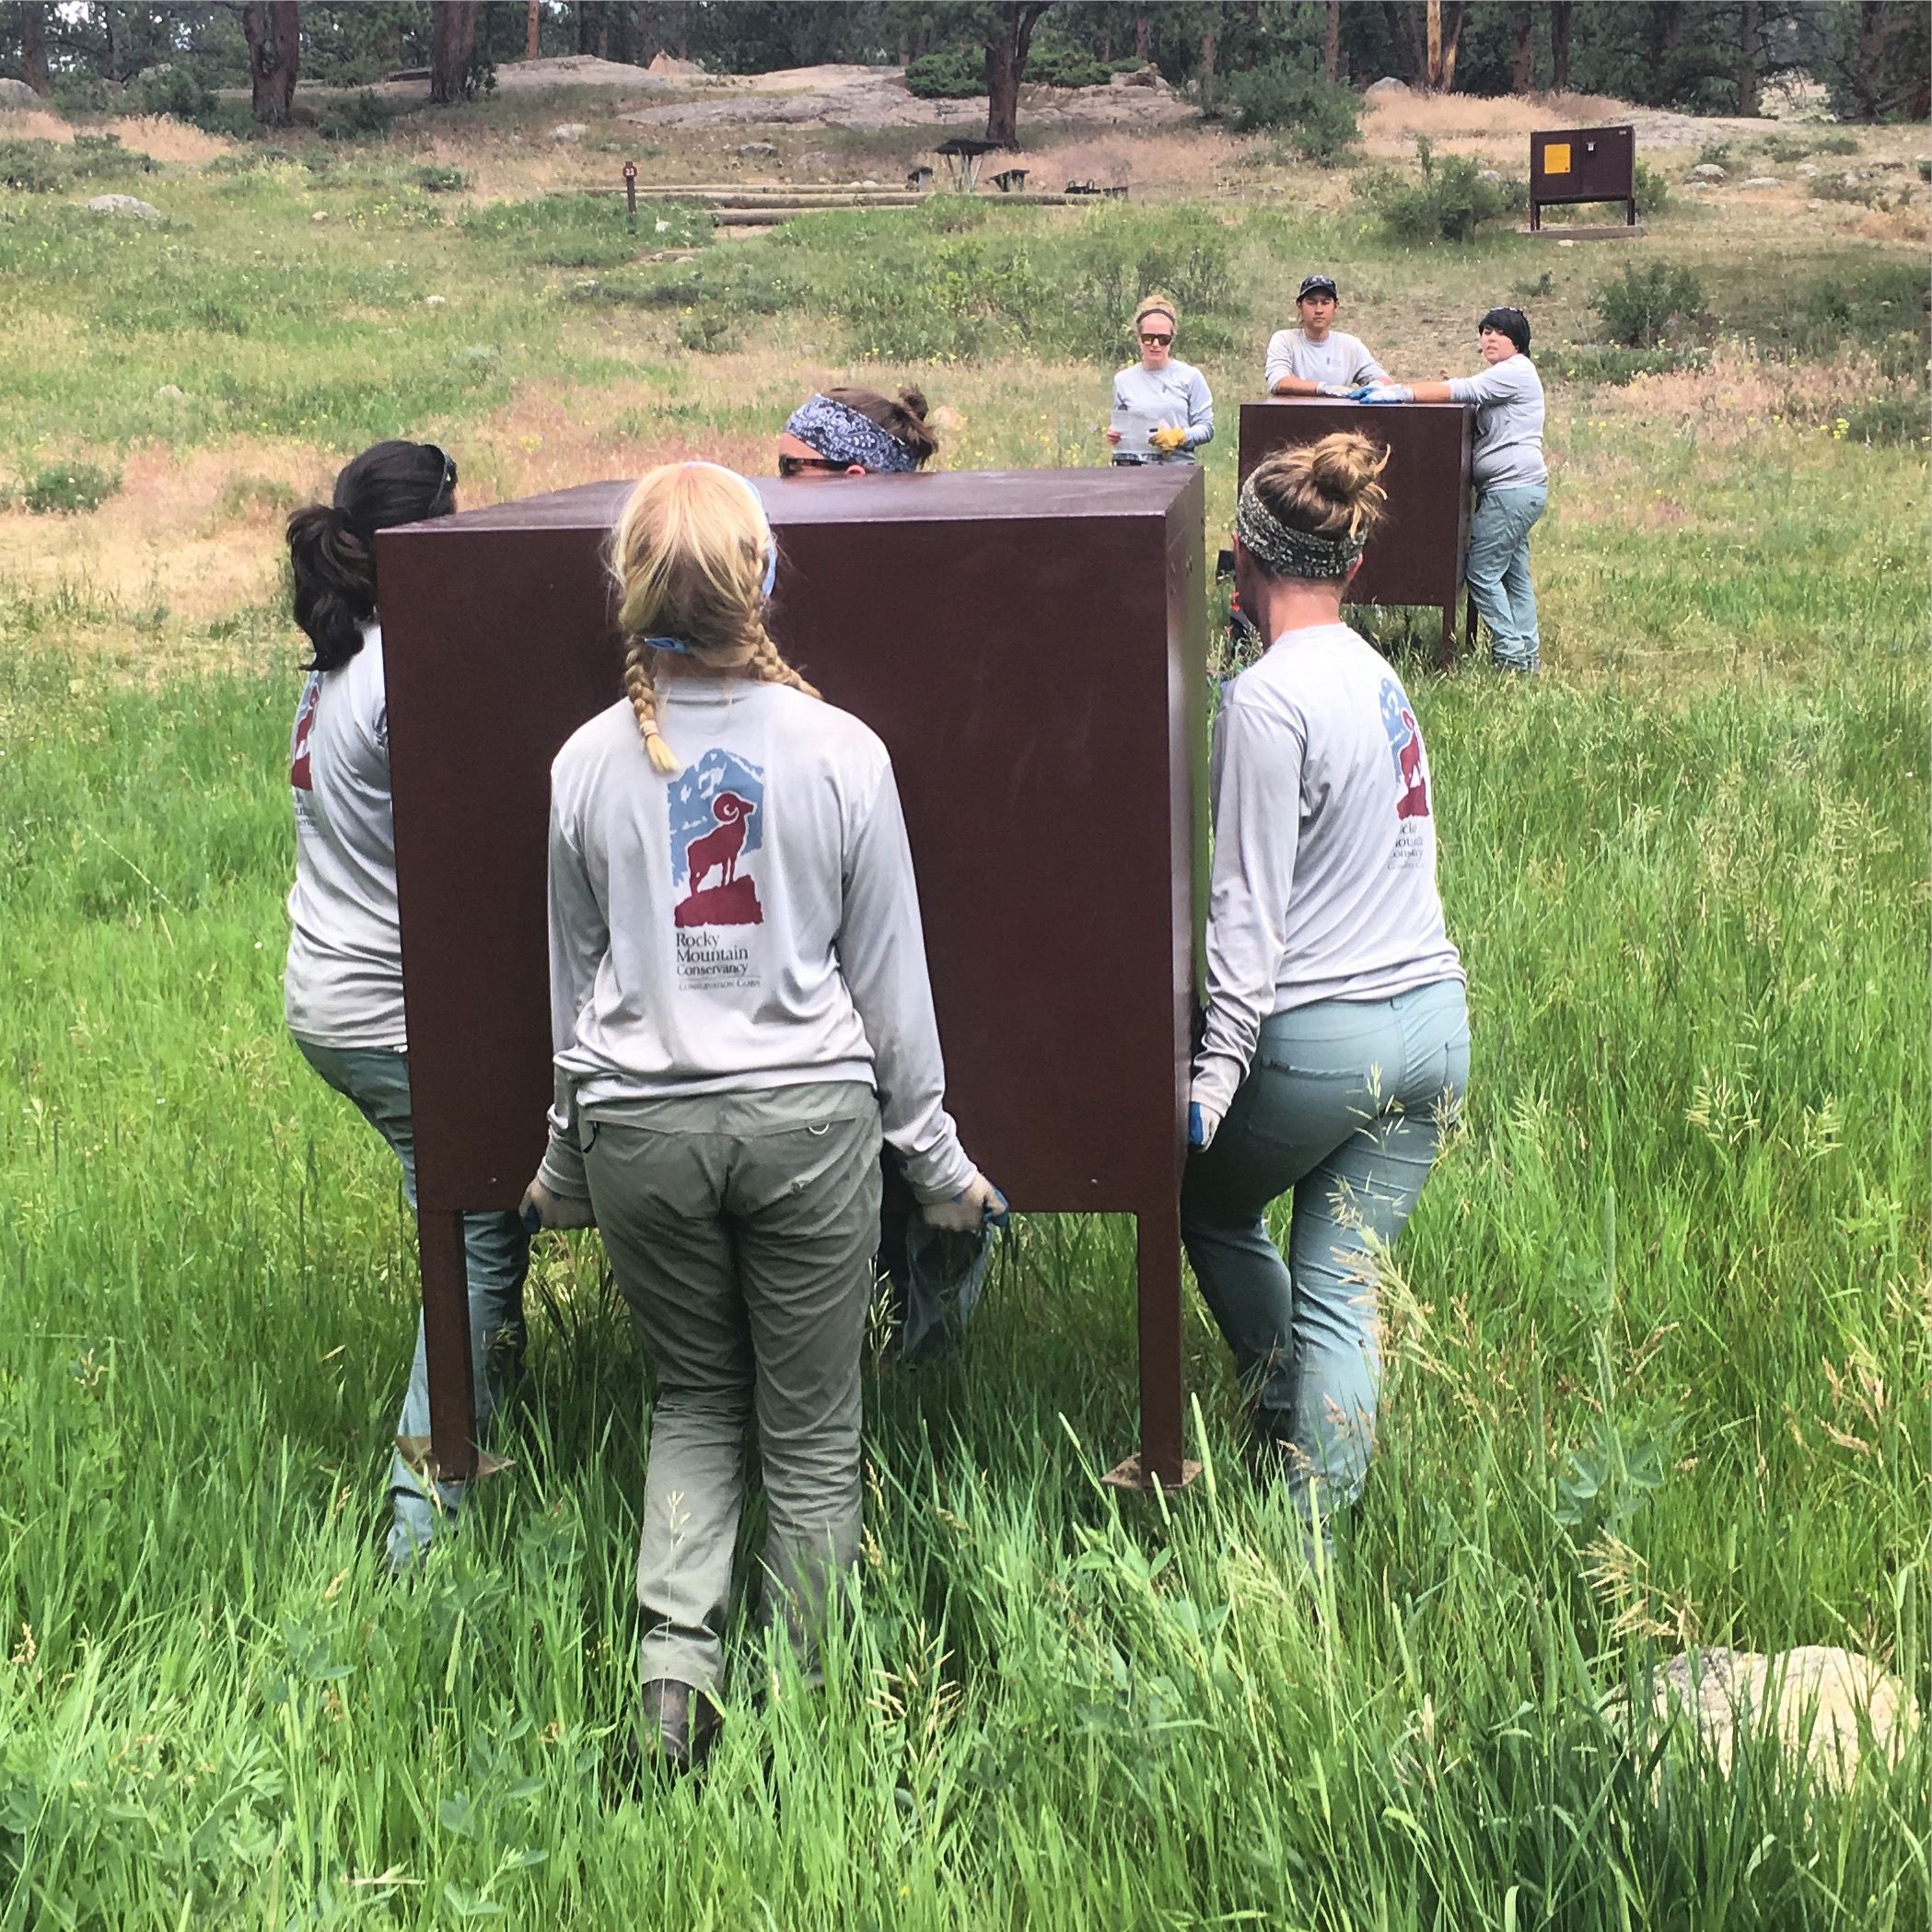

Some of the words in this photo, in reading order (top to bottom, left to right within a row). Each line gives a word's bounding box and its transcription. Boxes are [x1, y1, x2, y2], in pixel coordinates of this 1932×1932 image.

[676, 931, 719, 949] Rocky
[677, 945, 748, 963] Mountain
[677, 963, 748, 976] Conservancy
